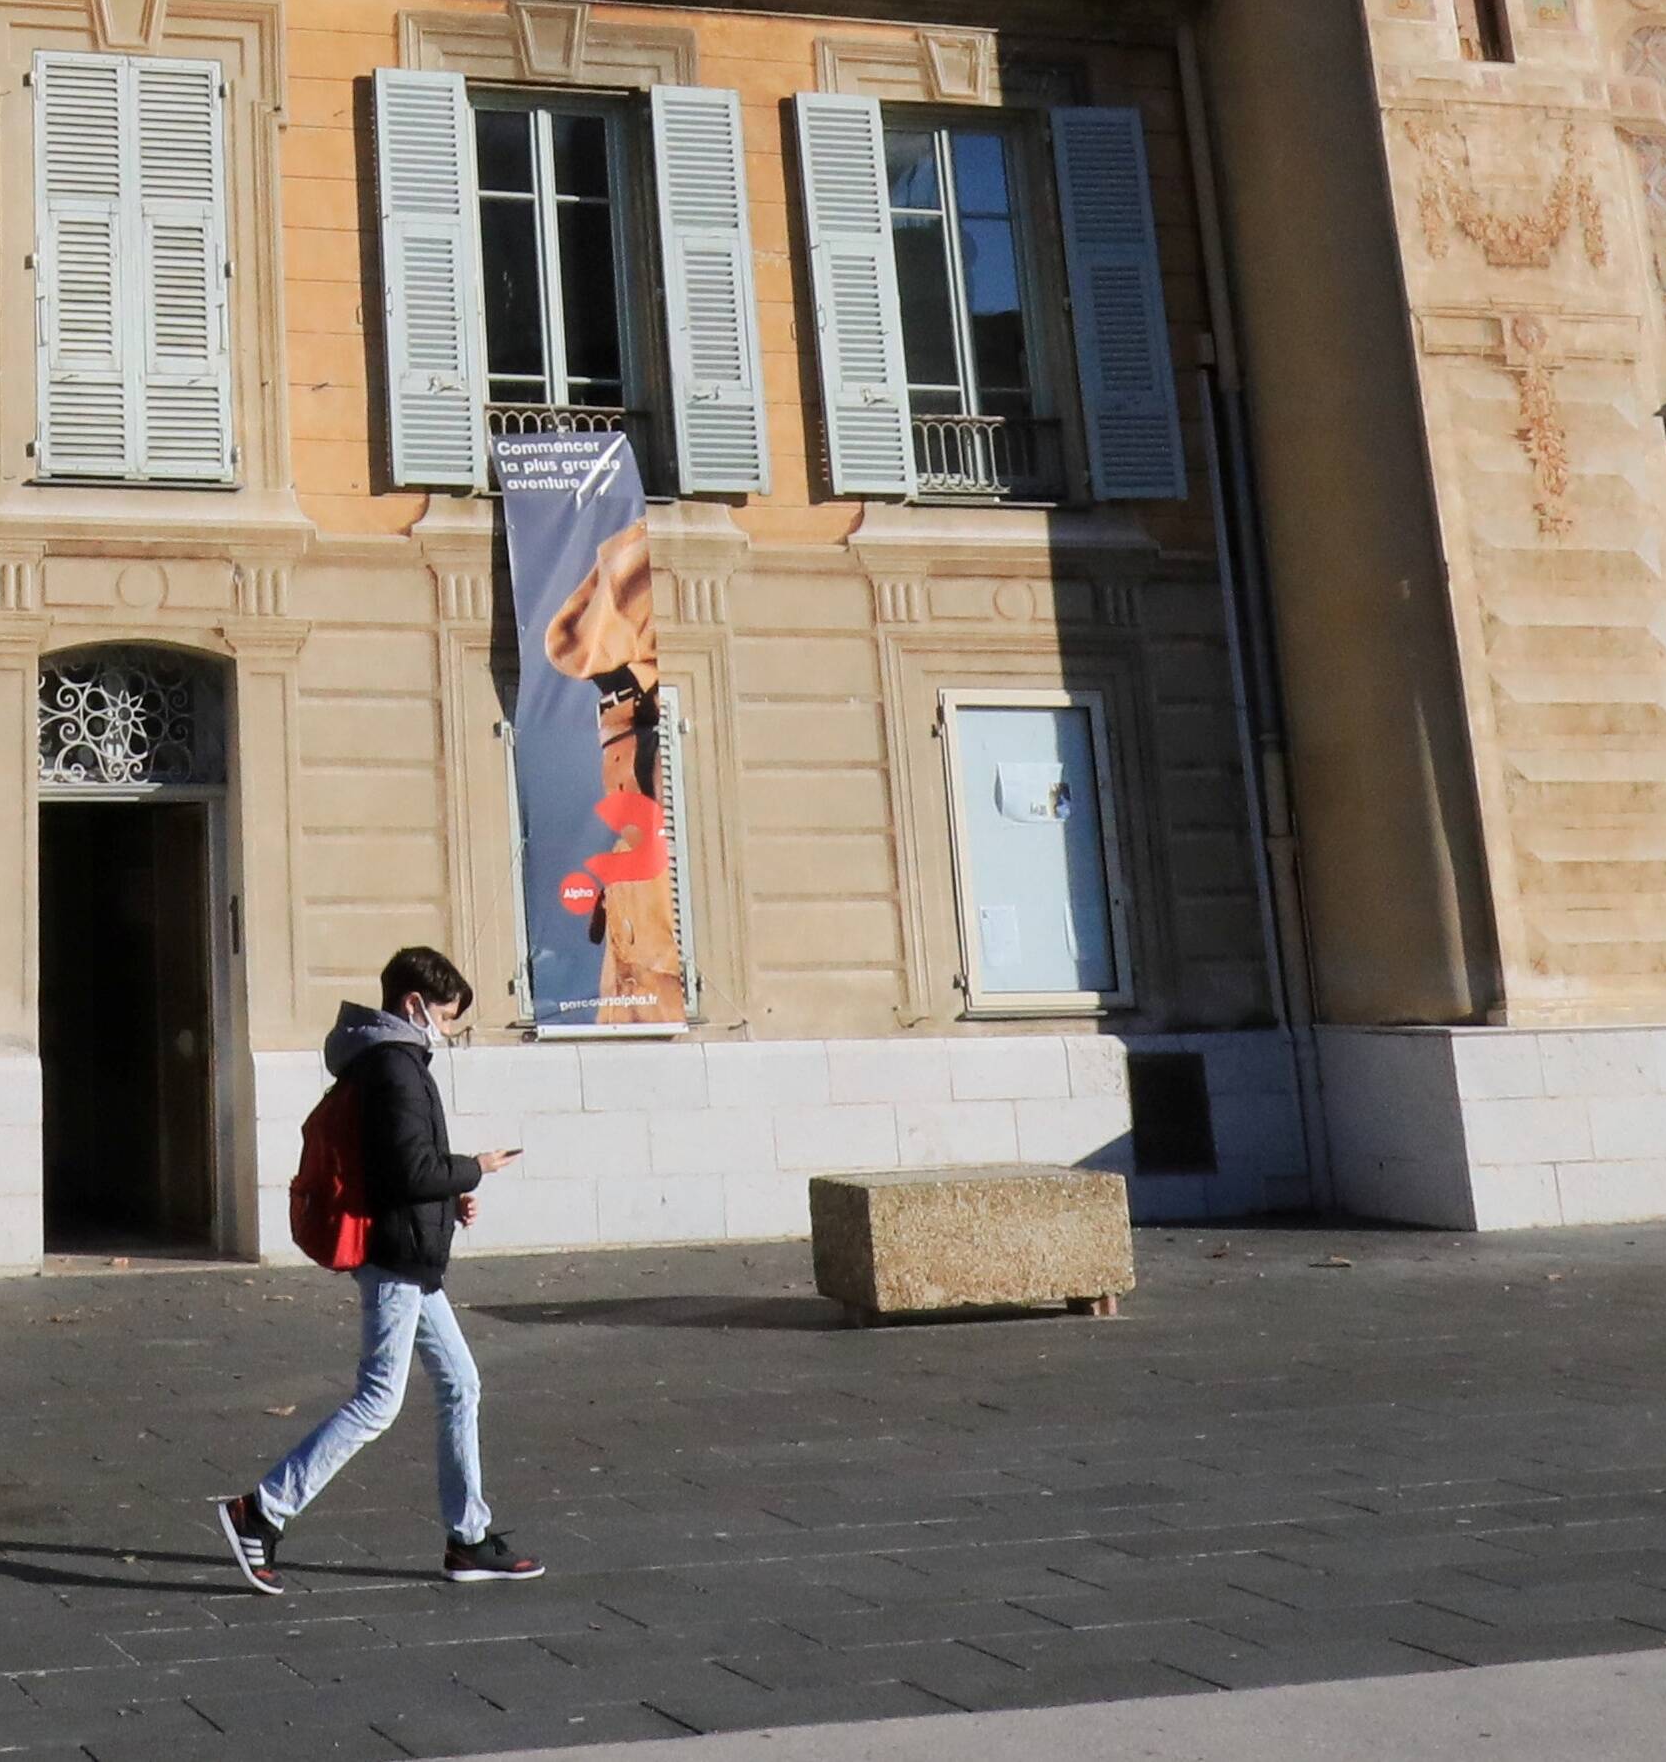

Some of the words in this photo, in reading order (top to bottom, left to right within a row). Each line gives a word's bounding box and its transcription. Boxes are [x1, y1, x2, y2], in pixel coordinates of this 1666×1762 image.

[497, 441, 600, 455] Commencer
[500, 460, 519, 474] la
[522, 458, 558, 475] plus
[506, 476, 580, 490] aventure
[563, 887, 594, 900] Alpha
[559, 993, 658, 1012] parcoursalpha.fr
